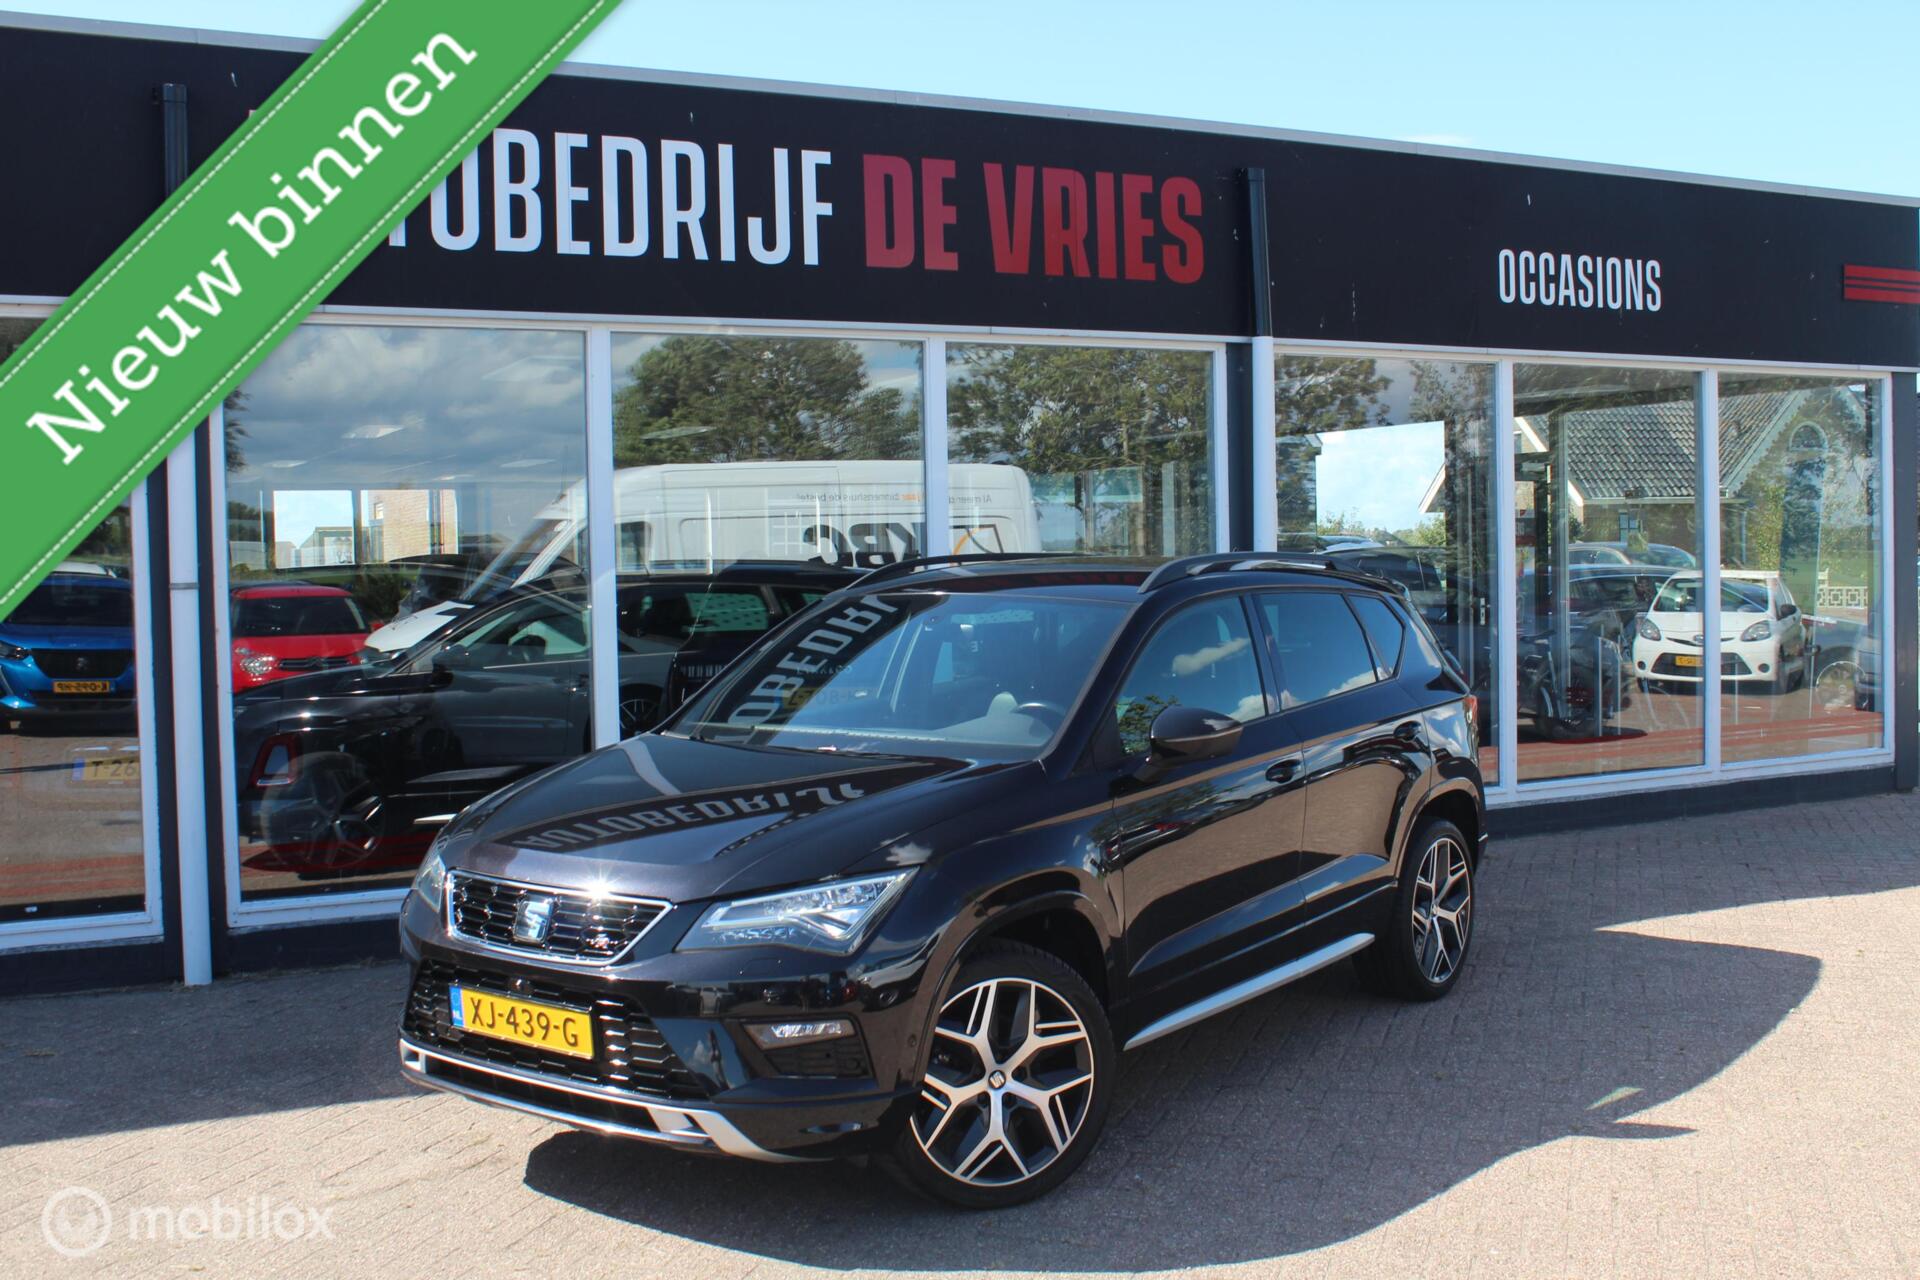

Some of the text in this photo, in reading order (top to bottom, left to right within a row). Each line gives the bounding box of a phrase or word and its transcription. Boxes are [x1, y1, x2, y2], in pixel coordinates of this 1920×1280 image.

[389, 127, 1205, 285] OBEDRIJF DE VRIES
[1498, 248, 1663, 313] OCCASIONS
[469, 996, 579, 1048] XJ-439-G
